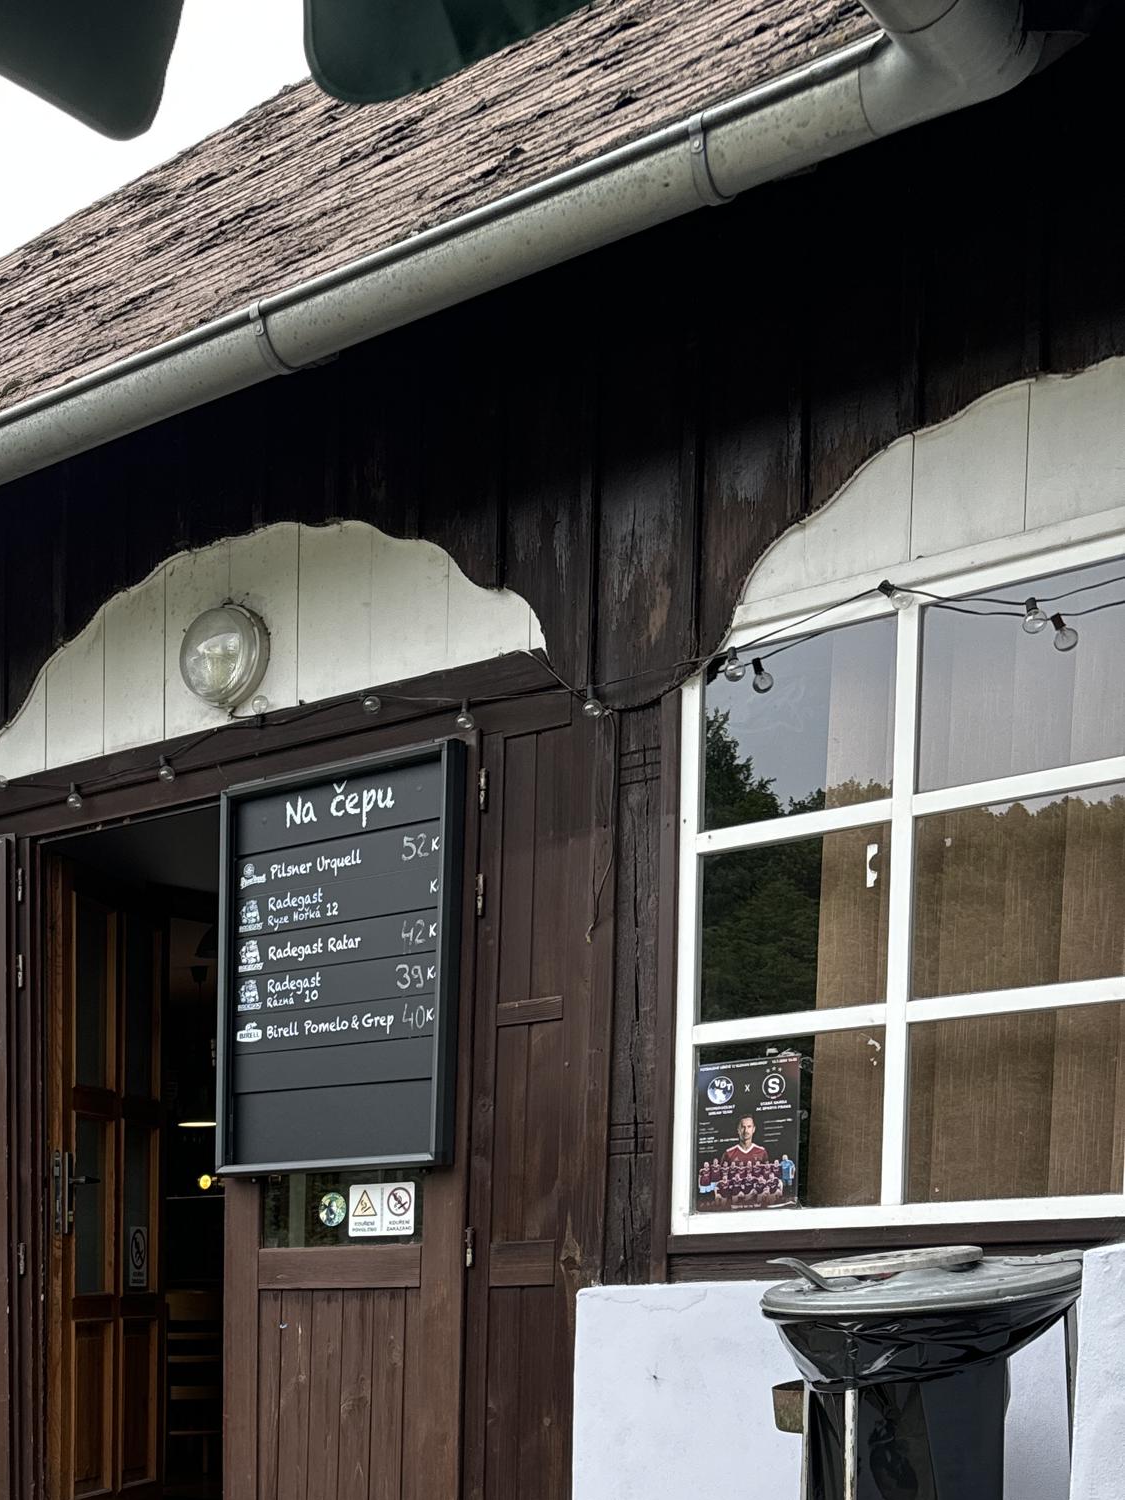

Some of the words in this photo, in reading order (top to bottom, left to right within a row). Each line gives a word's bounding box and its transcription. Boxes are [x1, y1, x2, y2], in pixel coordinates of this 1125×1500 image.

[286, 796, 317, 828] Na
[330, 780, 395, 828] čepu
[401, 833, 429, 861] 52
[270, 861, 312, 880] Pilsner
[317, 849, 362, 876] Urquell
[268, 887, 323, 911] Radegast
[267, 914, 289, 931] Ryze
[293, 905, 321, 922] Hořká
[326, 902, 339, 917] 12
[401, 919, 426, 945] 42
[268, 938, 323, 962] Radegast
[328, 934, 362, 952] Ratar
[267, 971, 321, 995] Radegast
[395, 963, 424, 990] 39
[266, 992, 294, 1008] Rázná
[304, 990, 319, 1003] 10
[266, 1021, 299, 1039] Birell
[304, 1016, 349, 1035] Pomelo
[361, 1013, 394, 1035] Grep
[402, 1003, 426, 1030] 40
[767, 1078, 780, 1094] S
